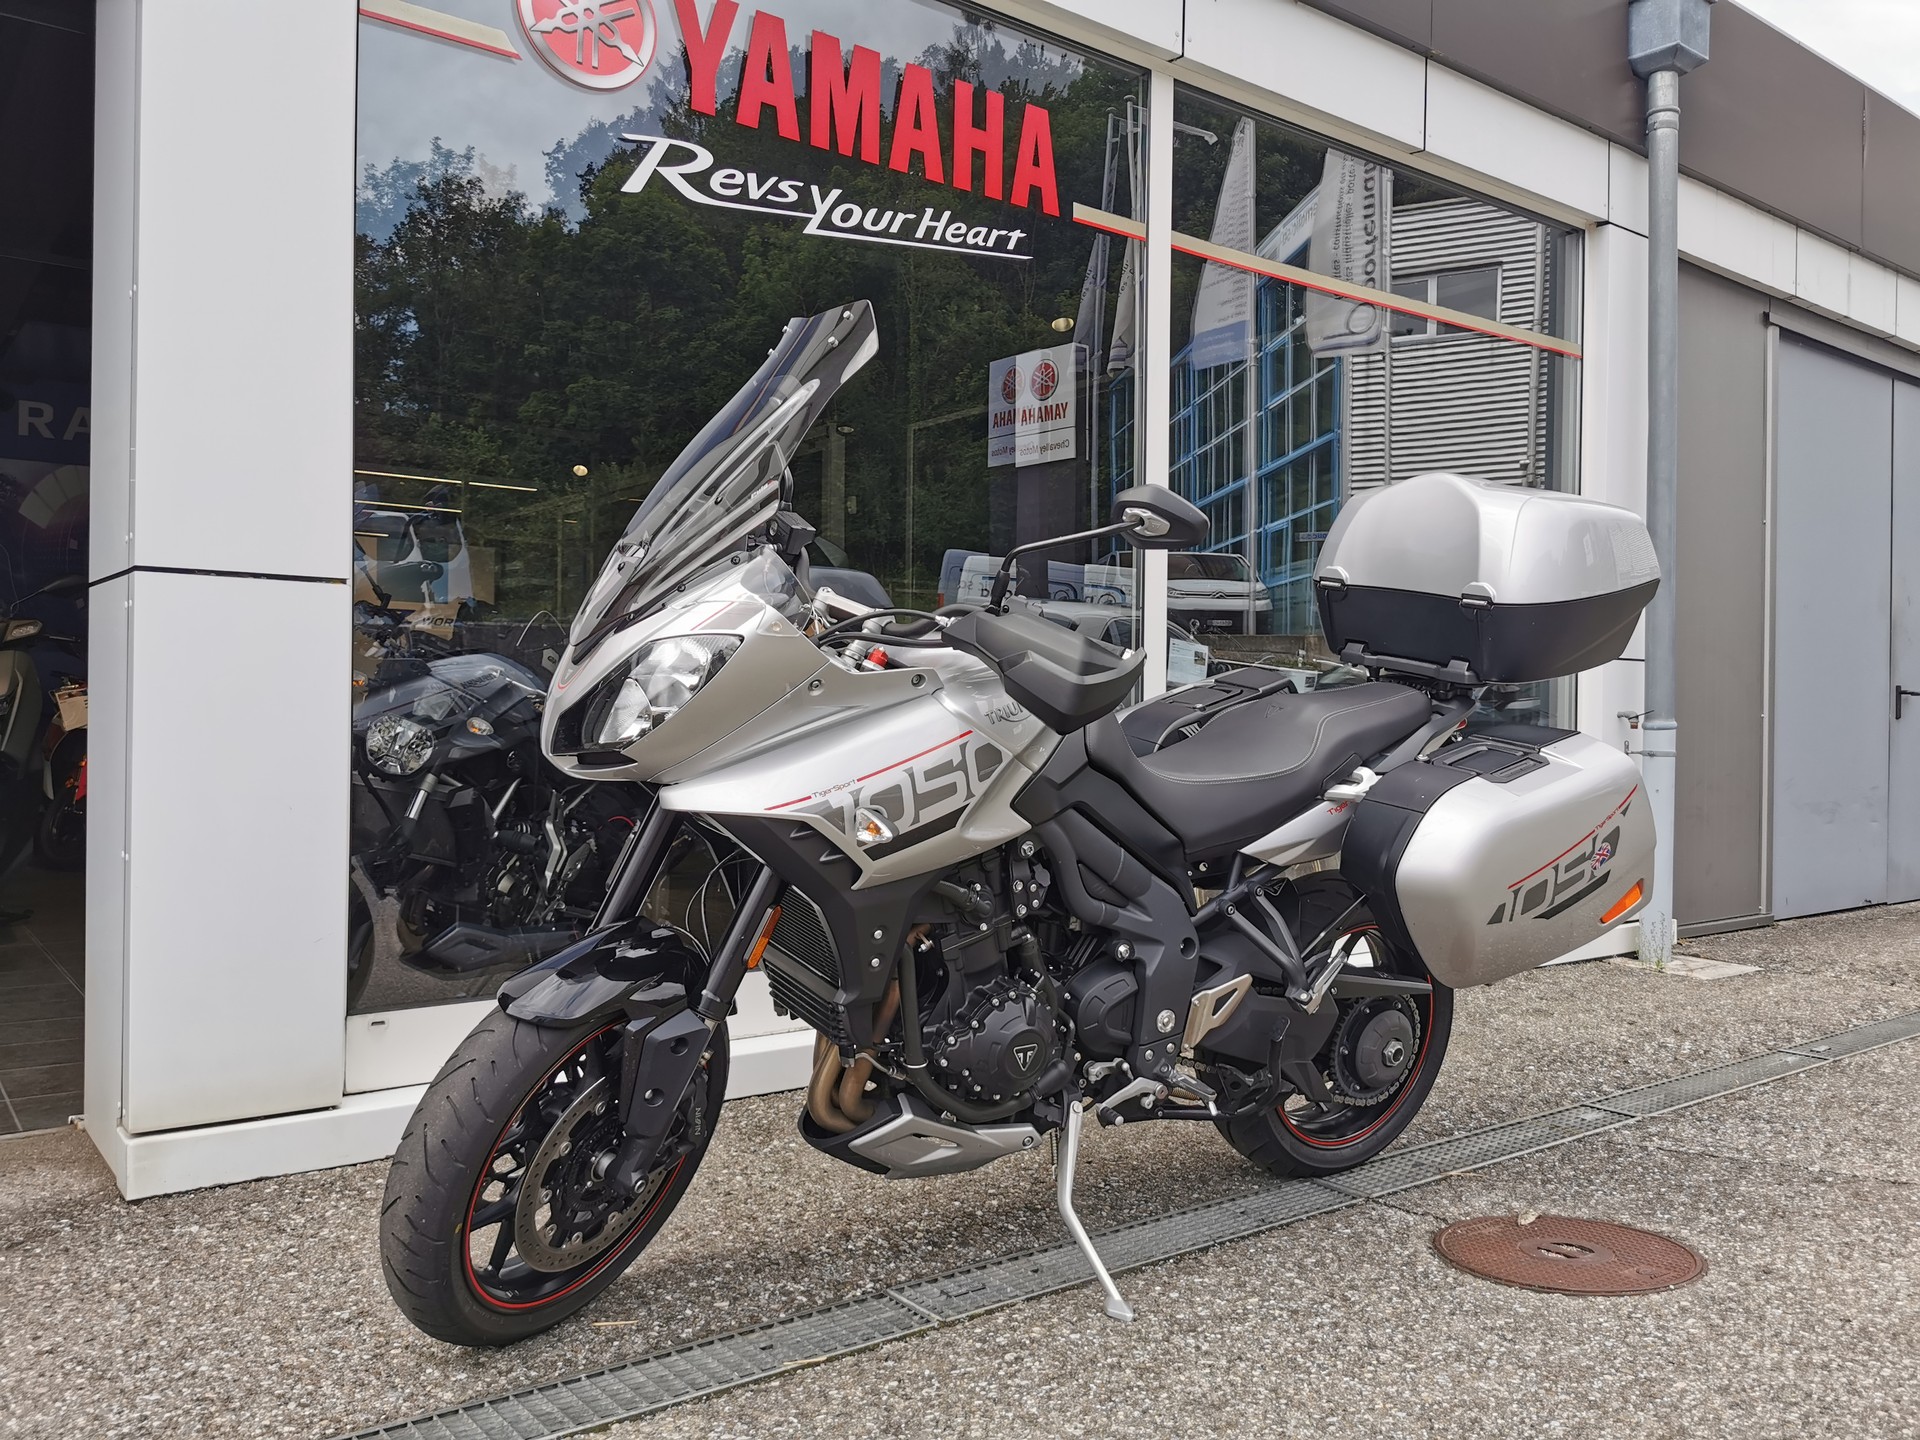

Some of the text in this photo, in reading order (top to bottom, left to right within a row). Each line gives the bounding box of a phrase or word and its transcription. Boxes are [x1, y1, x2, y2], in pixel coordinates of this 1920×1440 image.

[620, 133, 1028, 251] Revs Your Heart
[672, 0, 1060, 217] YAMAHA
